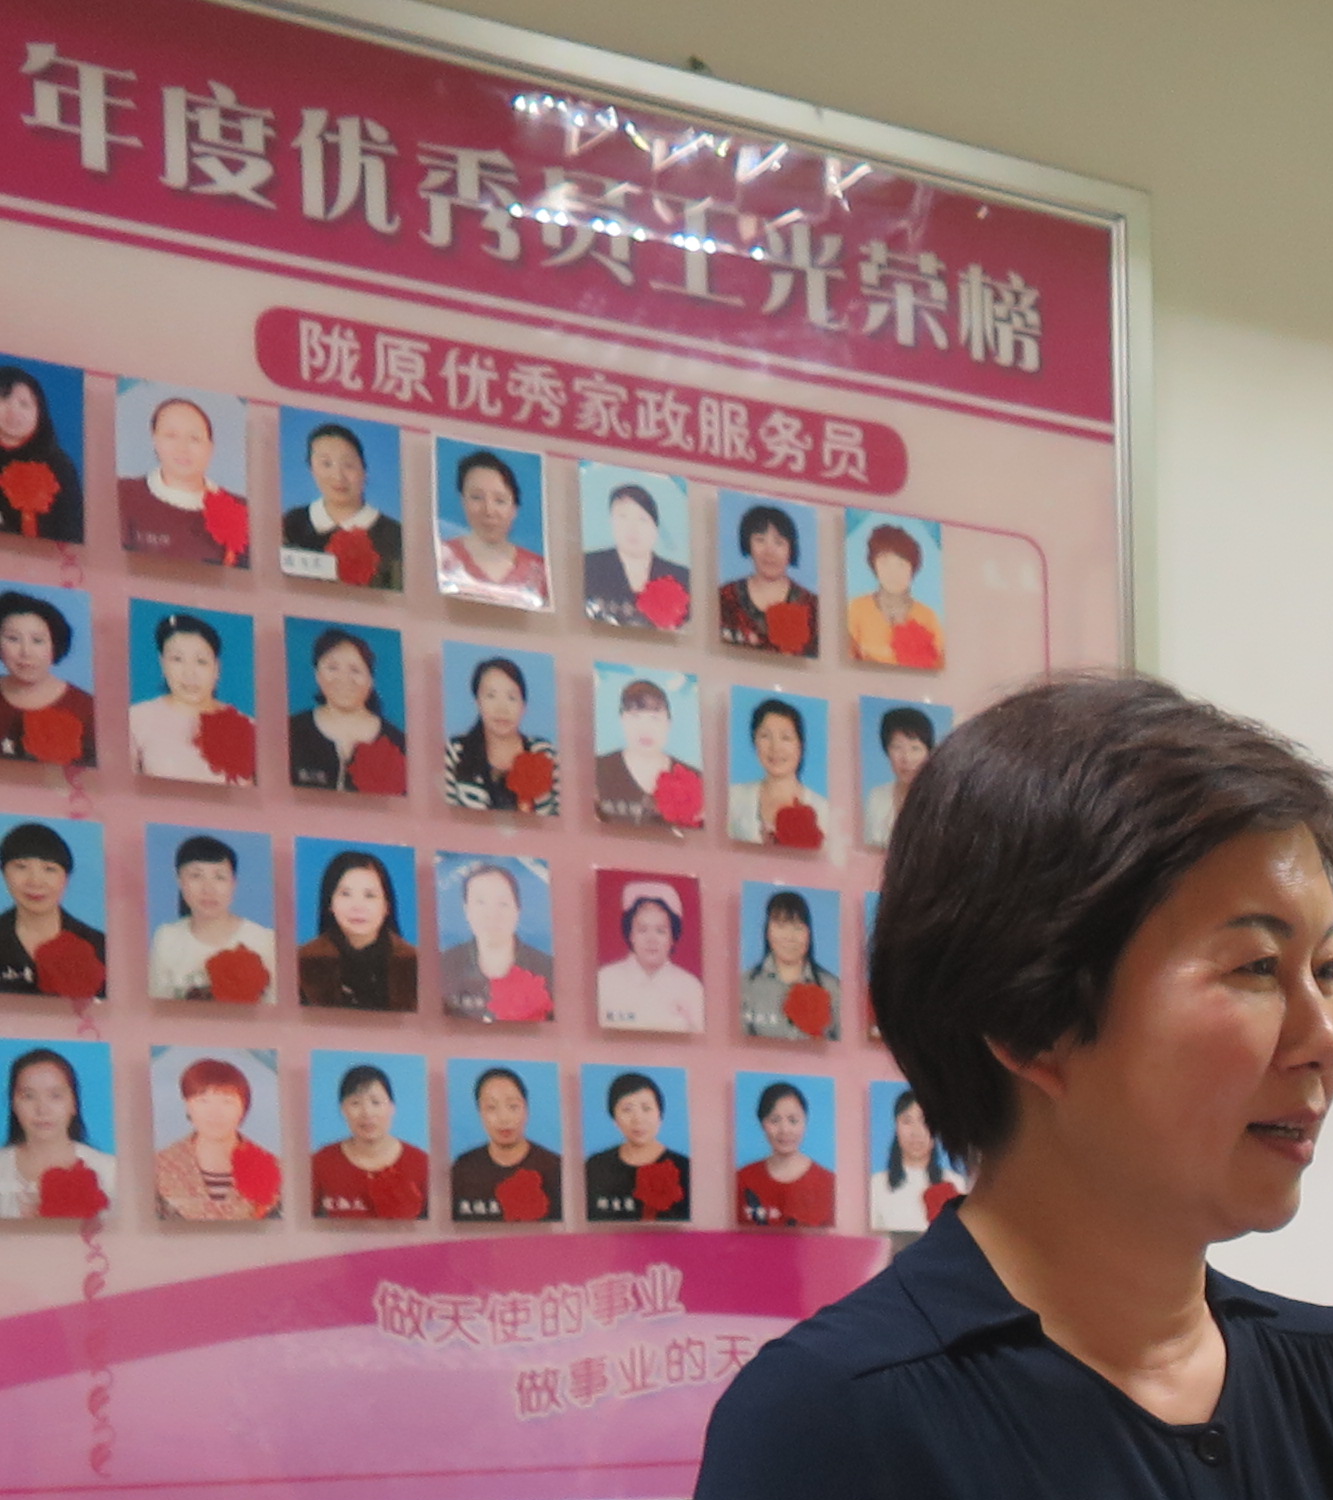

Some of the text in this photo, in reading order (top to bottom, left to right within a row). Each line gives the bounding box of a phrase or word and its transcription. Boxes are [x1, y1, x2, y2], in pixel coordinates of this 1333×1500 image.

[20, 42, 1044, 375] 年度优秀员工光荣榜
[298, 318, 872, 486] 陇原优秀家政服务员
[374, 1262, 684, 1346] 做天使的事业
